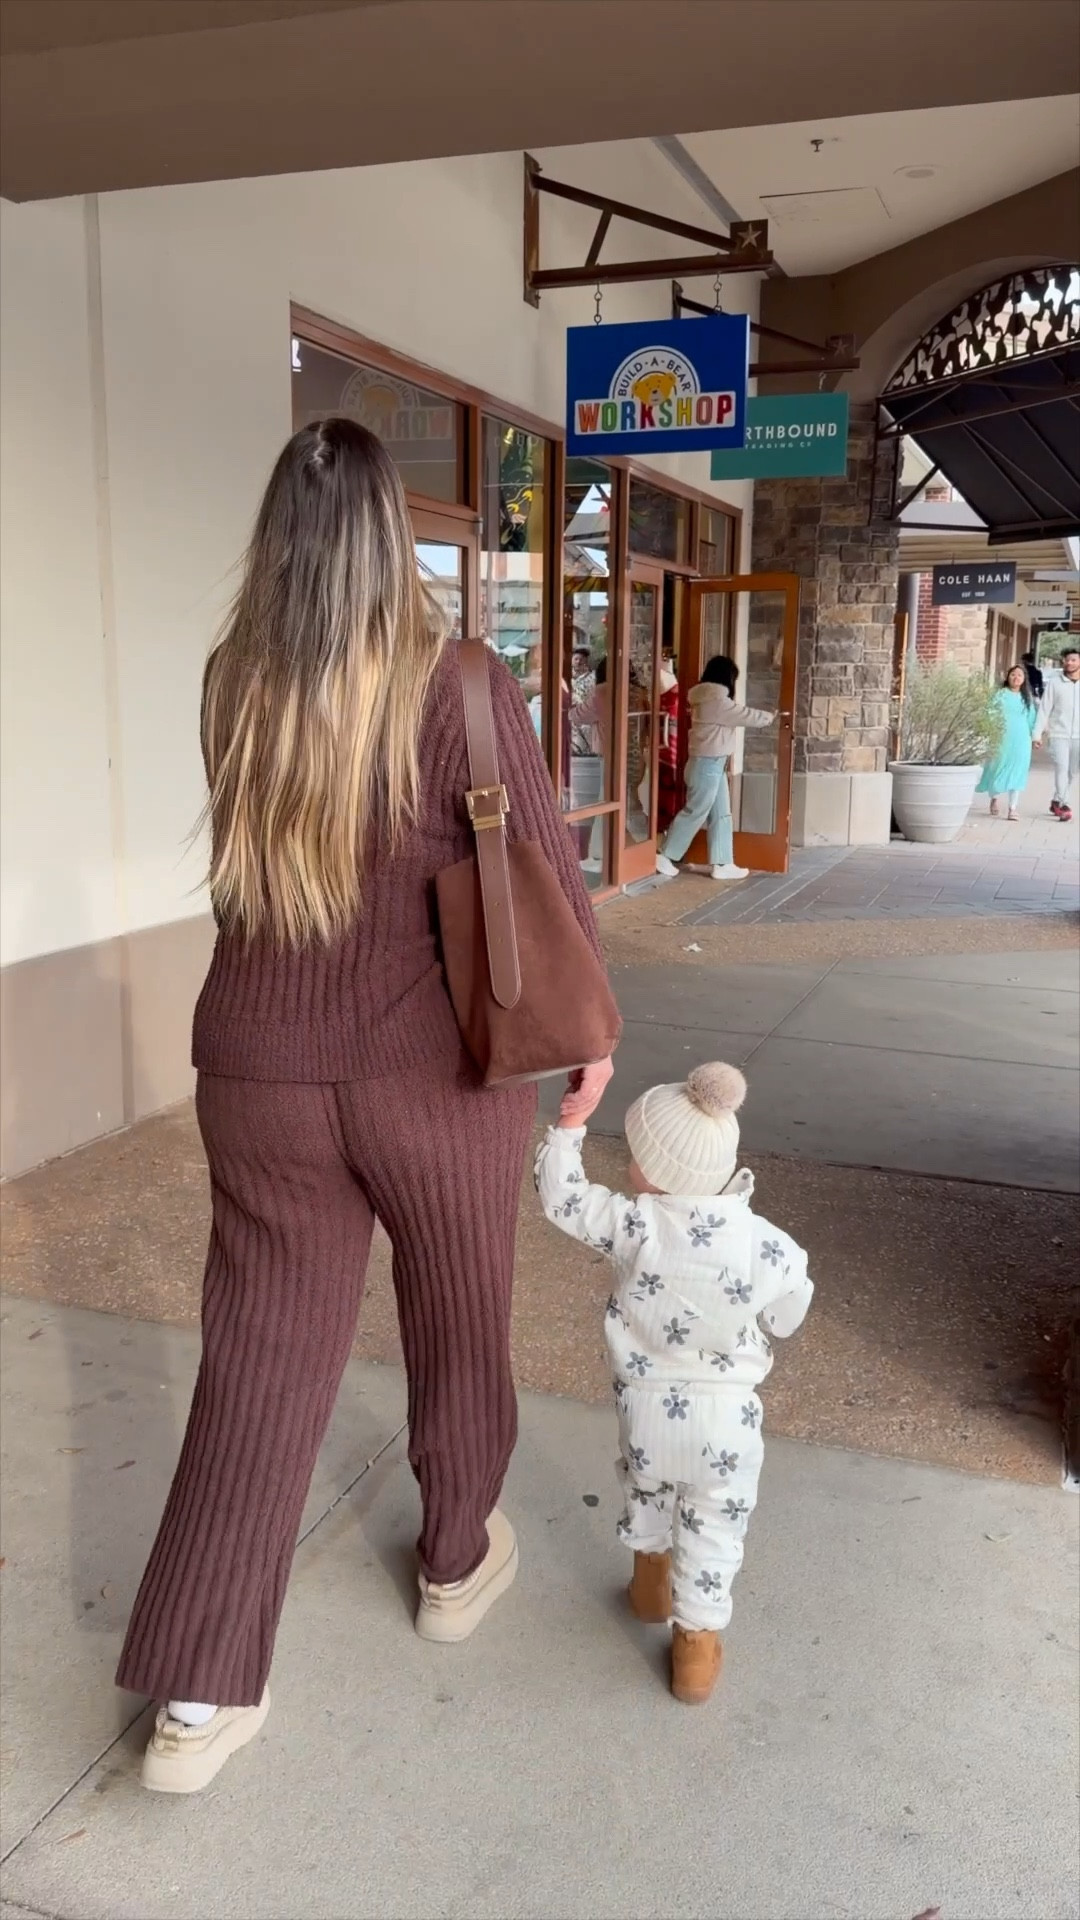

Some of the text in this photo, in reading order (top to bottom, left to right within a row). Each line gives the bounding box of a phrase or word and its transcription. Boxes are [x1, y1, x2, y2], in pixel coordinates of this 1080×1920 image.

[578, 395, 732, 433] WORKSHOP
[938, 573, 1011, 585] COLE HAAN
